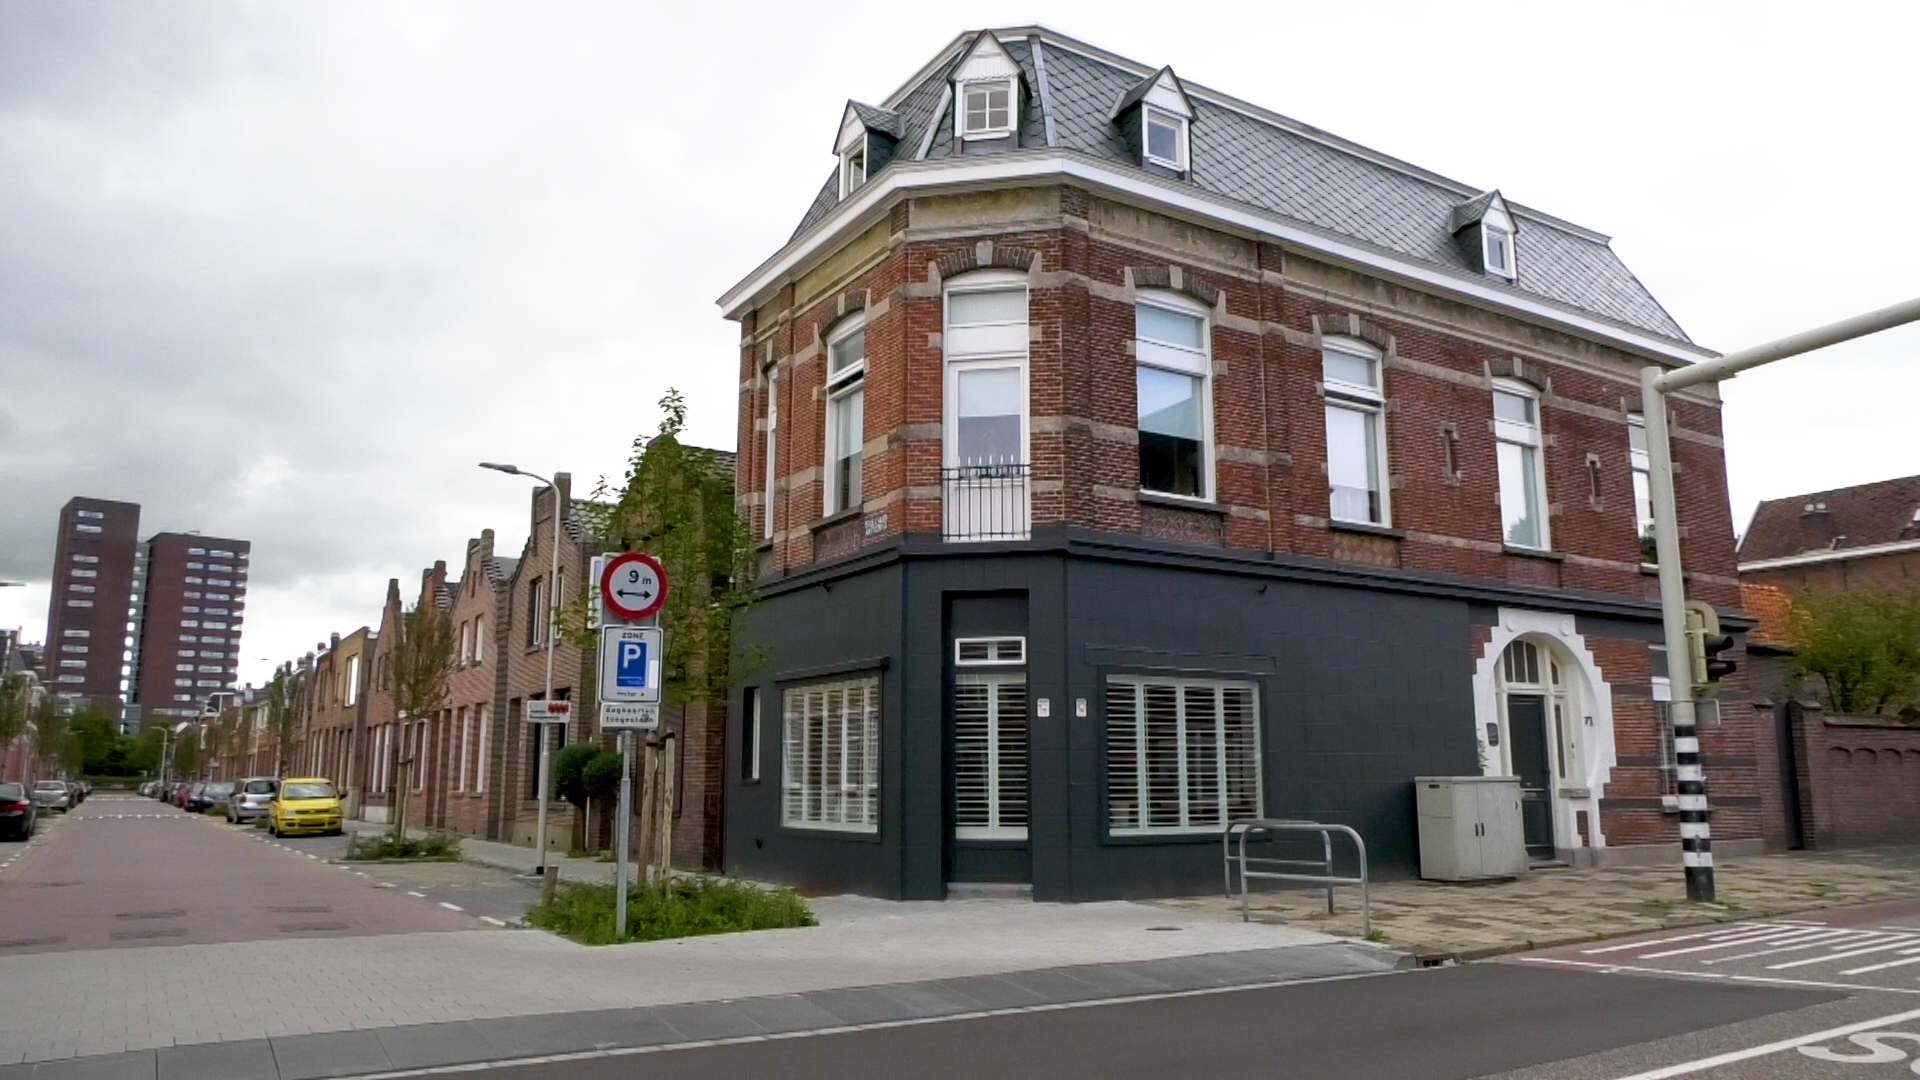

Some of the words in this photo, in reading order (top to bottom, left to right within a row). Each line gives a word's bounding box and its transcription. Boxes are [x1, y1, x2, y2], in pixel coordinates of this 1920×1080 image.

[628, 570, 639, 583] 9
[642, 577, 652, 585] m
[621, 632, 645, 640] ZONE
[622, 643, 641, 669] P
